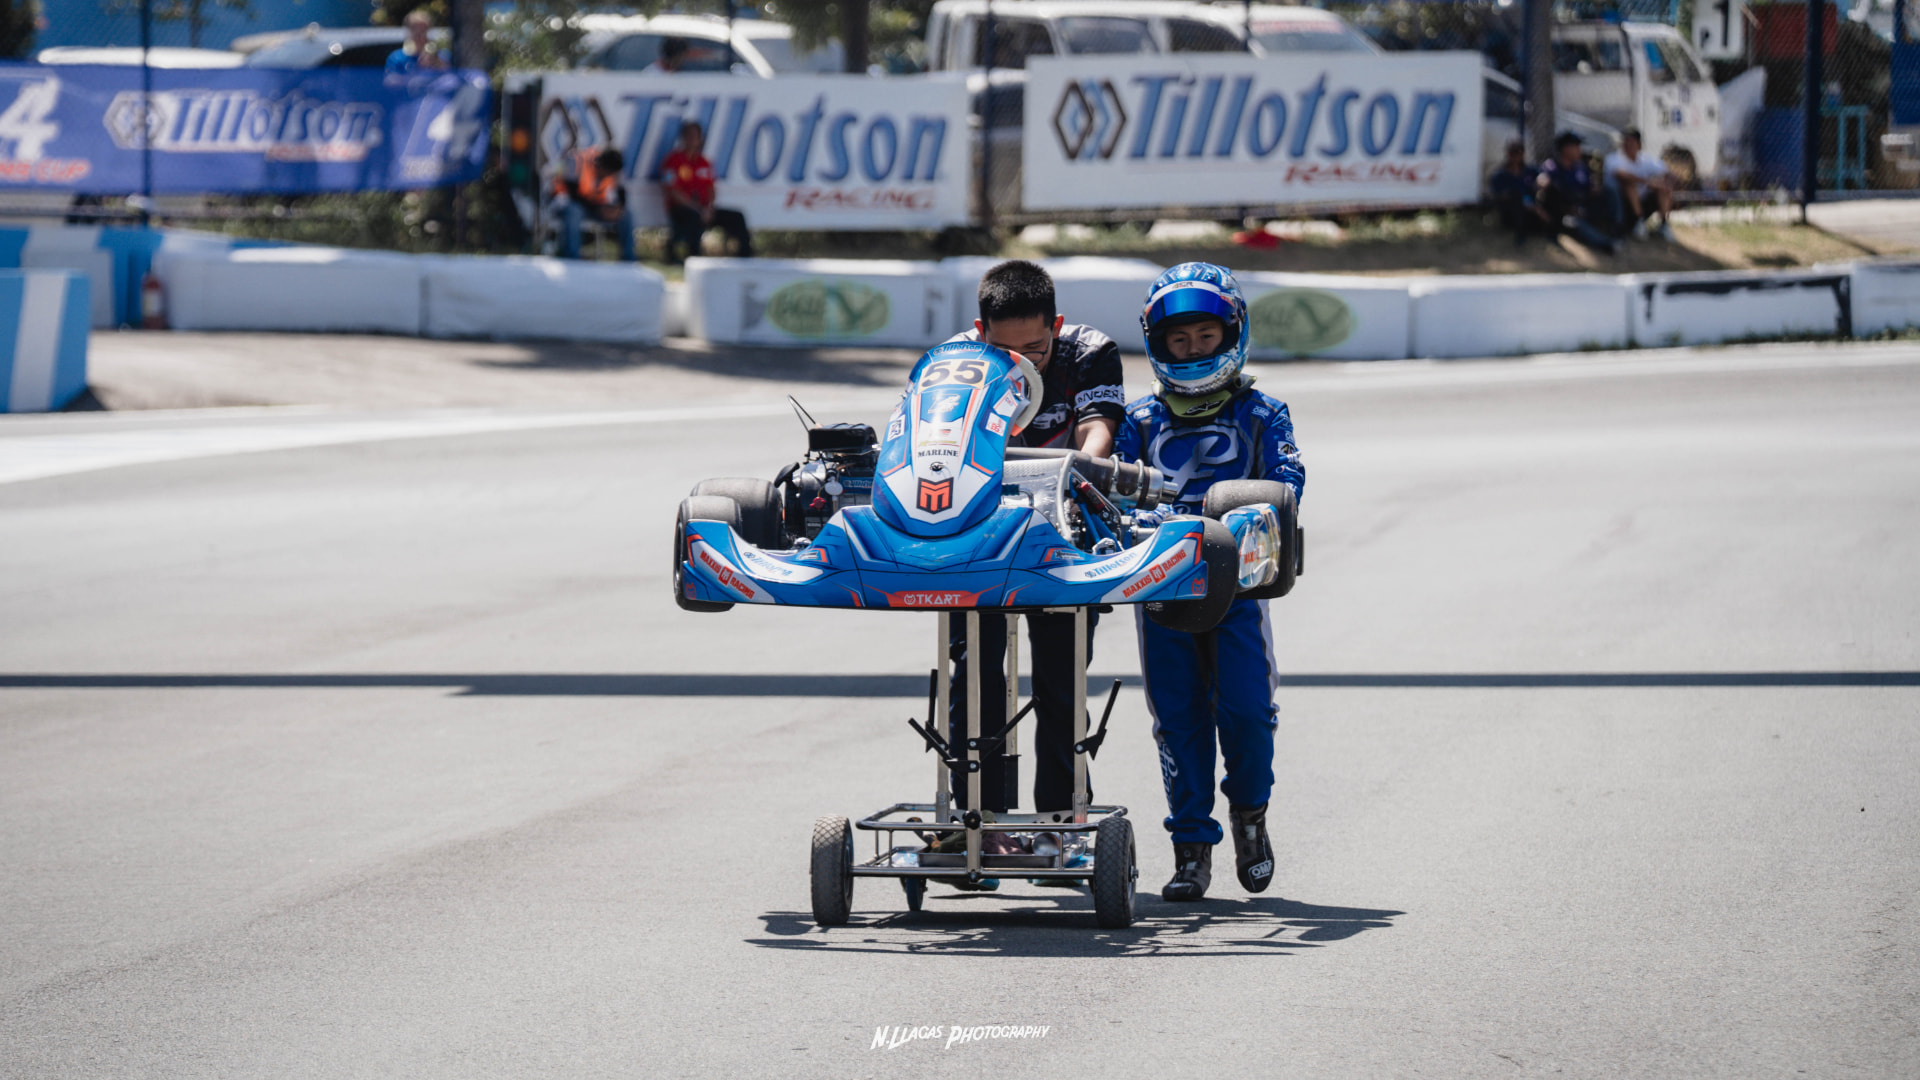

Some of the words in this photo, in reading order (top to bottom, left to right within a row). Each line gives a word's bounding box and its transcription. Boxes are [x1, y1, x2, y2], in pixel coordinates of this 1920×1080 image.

[166, 88, 381, 150] Tillotson
[1129, 72, 1456, 159] Tillotson
[617, 94, 947, 182] Tillotson
[1284, 162, 1441, 185] RACING
[785, 188, 933, 210] RACING
[921, 360, 985, 388] 55
[918, 448, 959, 457] MARLINE
[1122, 574, 1153, 599] MAXXIS
[1161, 548, 1187, 573] RACING
[730, 576, 755, 600] RACING
